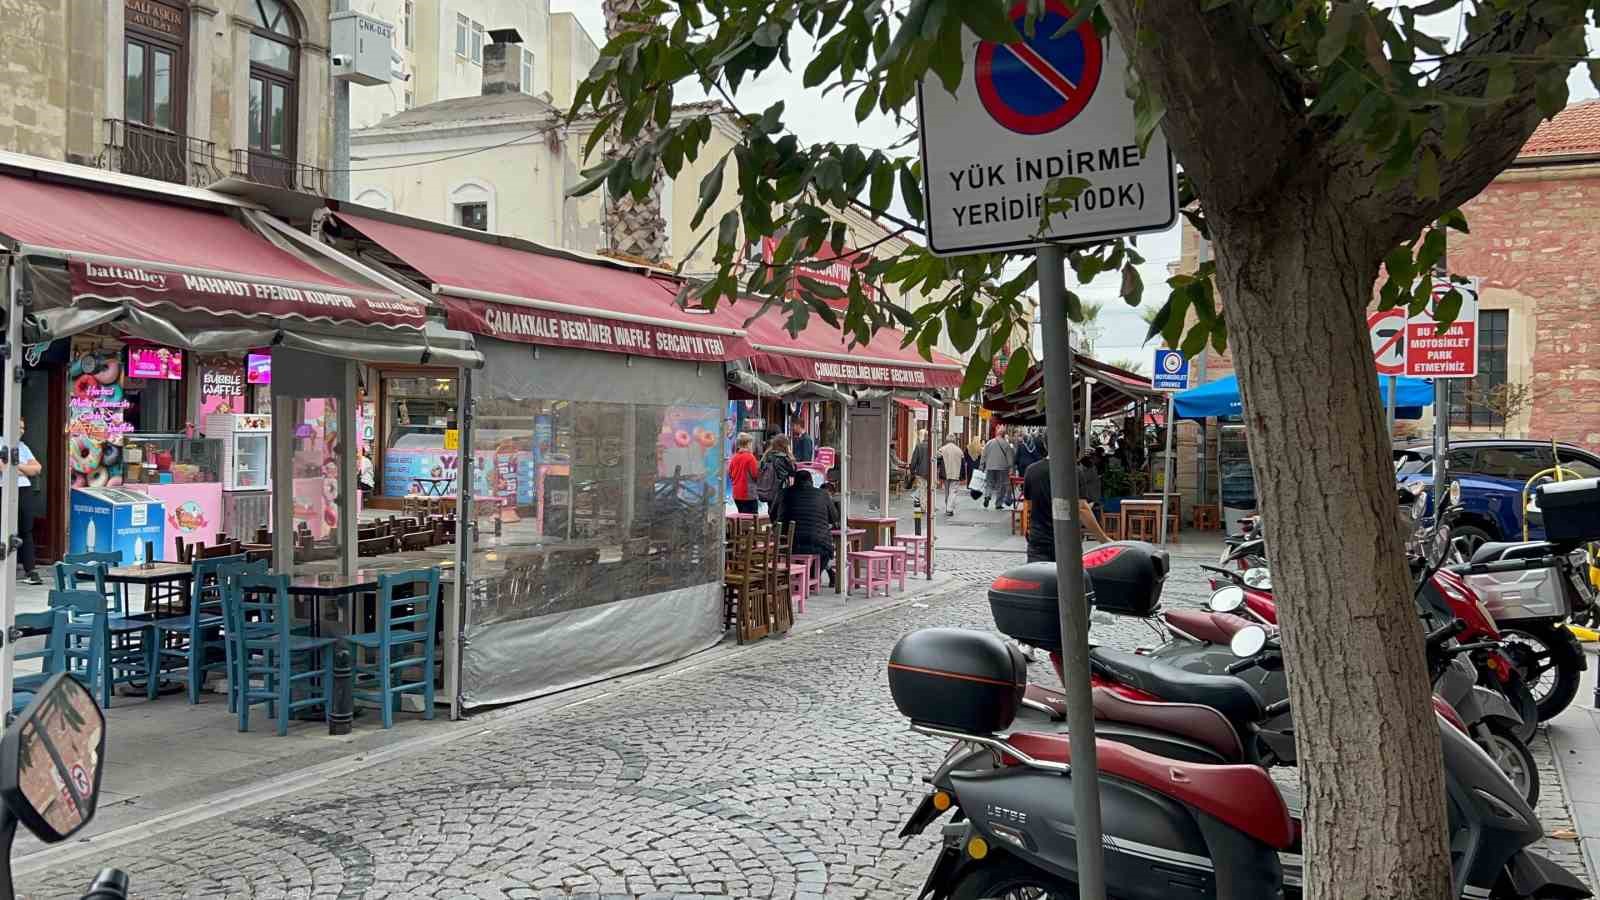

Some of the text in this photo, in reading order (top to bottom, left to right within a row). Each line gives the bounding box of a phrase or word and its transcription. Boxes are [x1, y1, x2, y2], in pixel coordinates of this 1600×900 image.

[950, 144, 1140, 191] YÜK İNDİRME
[86, 262, 168, 288] battalbey
[183, 274, 251, 297] MAHMUT
[485, 308, 560, 339] ÇANAKKALE
[560, 318, 612, 345] BERLİNER
[613, 326, 652, 350] WAFFLE
[703, 335, 726, 356] YERİ
[1417, 326, 1431, 337] BU
[1410, 336, 1470, 349] MOTOSİKLET
[1427, 350, 1453, 360] PARK
[1414, 360, 1465, 373] ETMEYİNİZ
[203, 373, 241, 385] BUBBLE
[203, 384, 241, 396] WAFFLE
